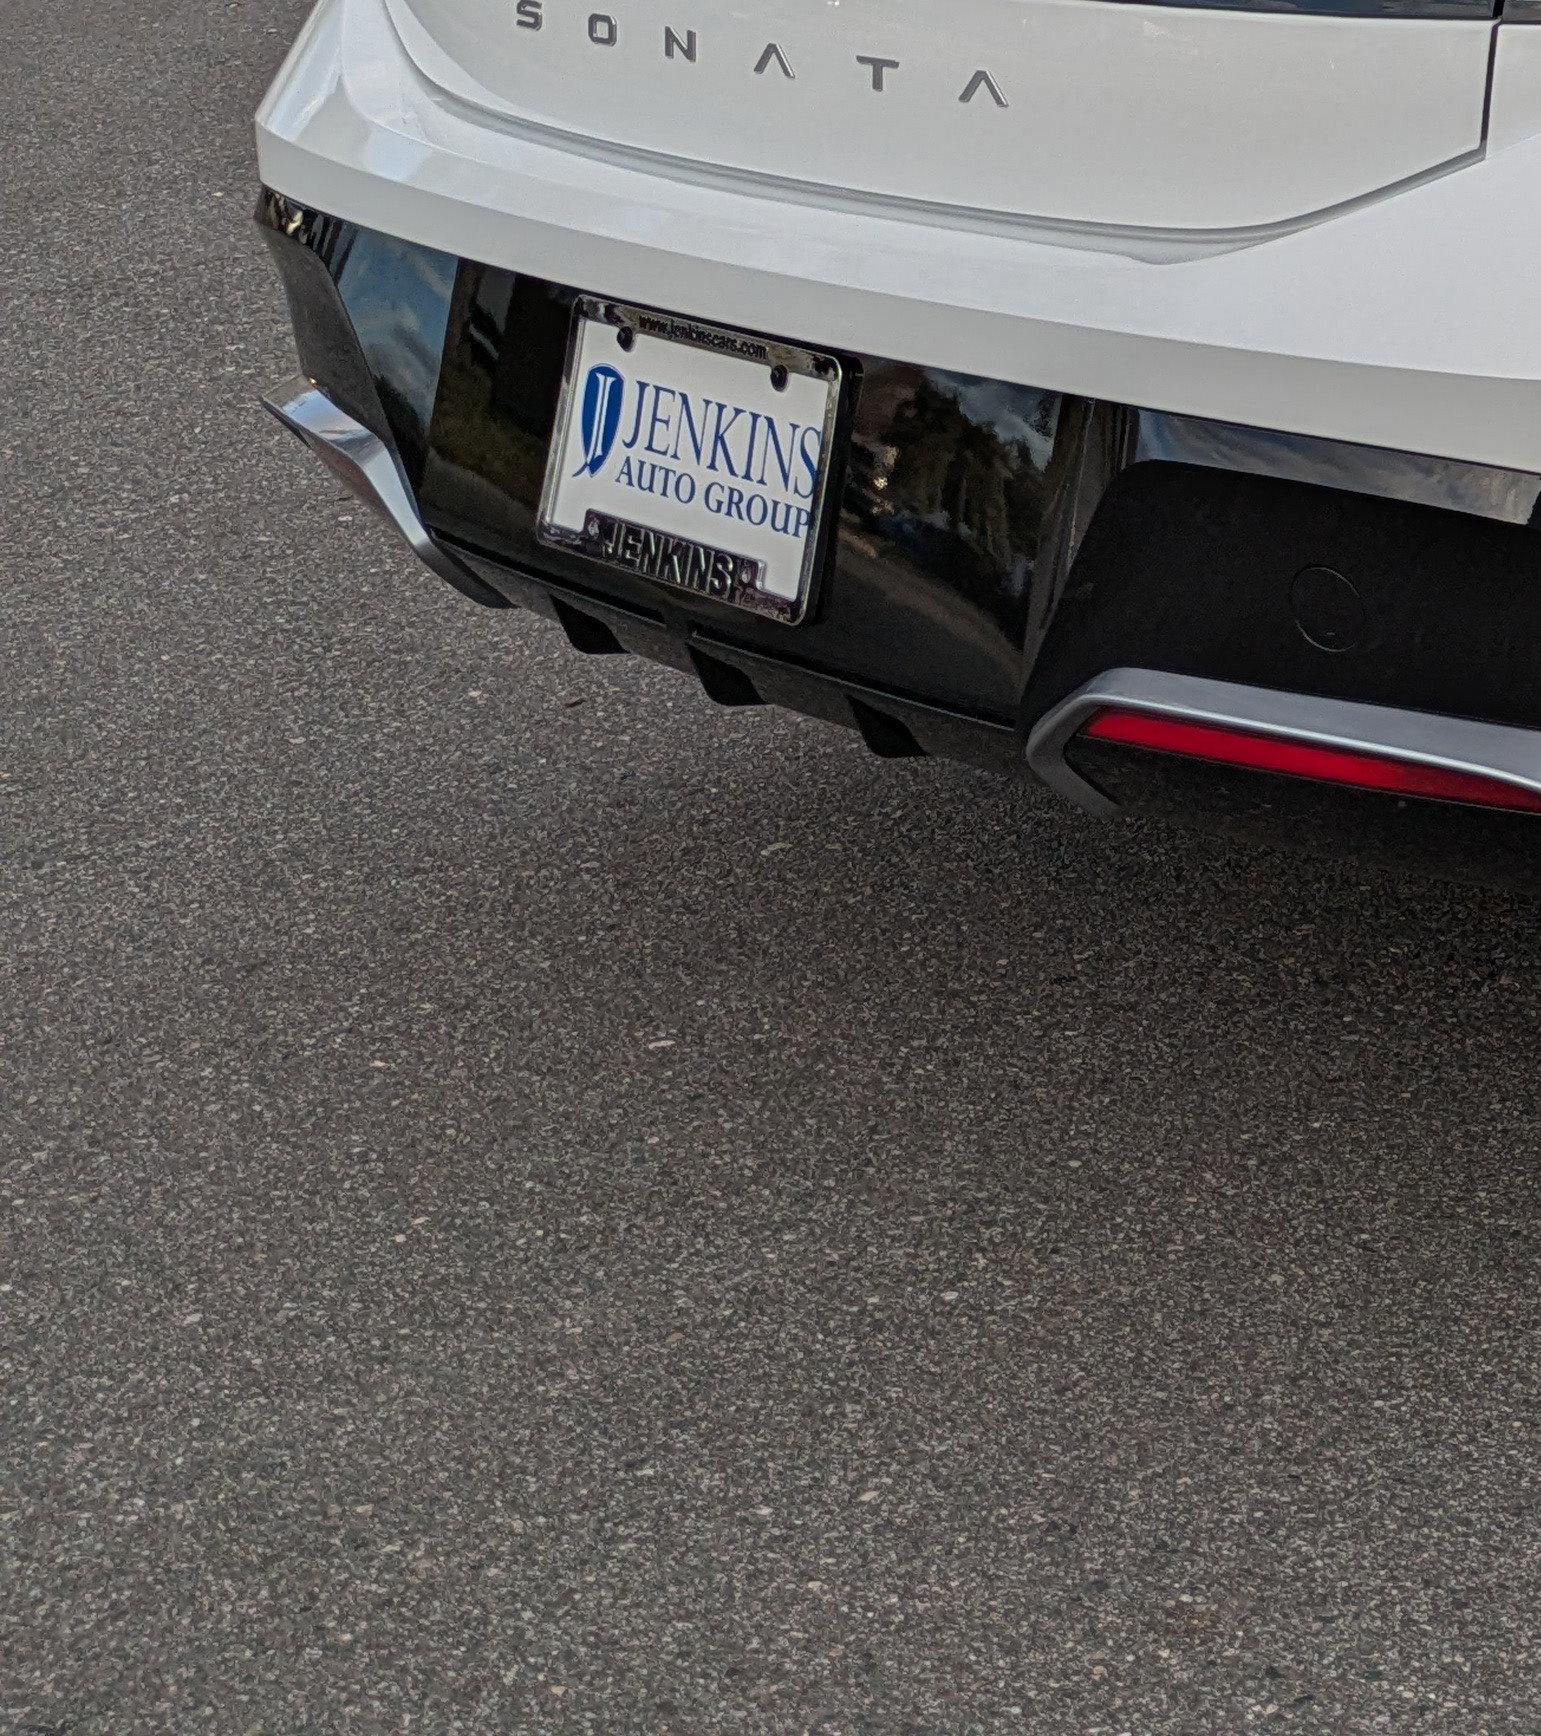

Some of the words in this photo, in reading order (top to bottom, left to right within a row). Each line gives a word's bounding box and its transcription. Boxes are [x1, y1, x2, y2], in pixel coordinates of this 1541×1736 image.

[638, 314, 768, 360] www.jenkinscars.com
[622, 380, 822, 500] JENKINS
[615, 455, 697, 505] AUTO
[704, 481, 811, 539] GROUP
[603, 520, 735, 595] JENKINS
